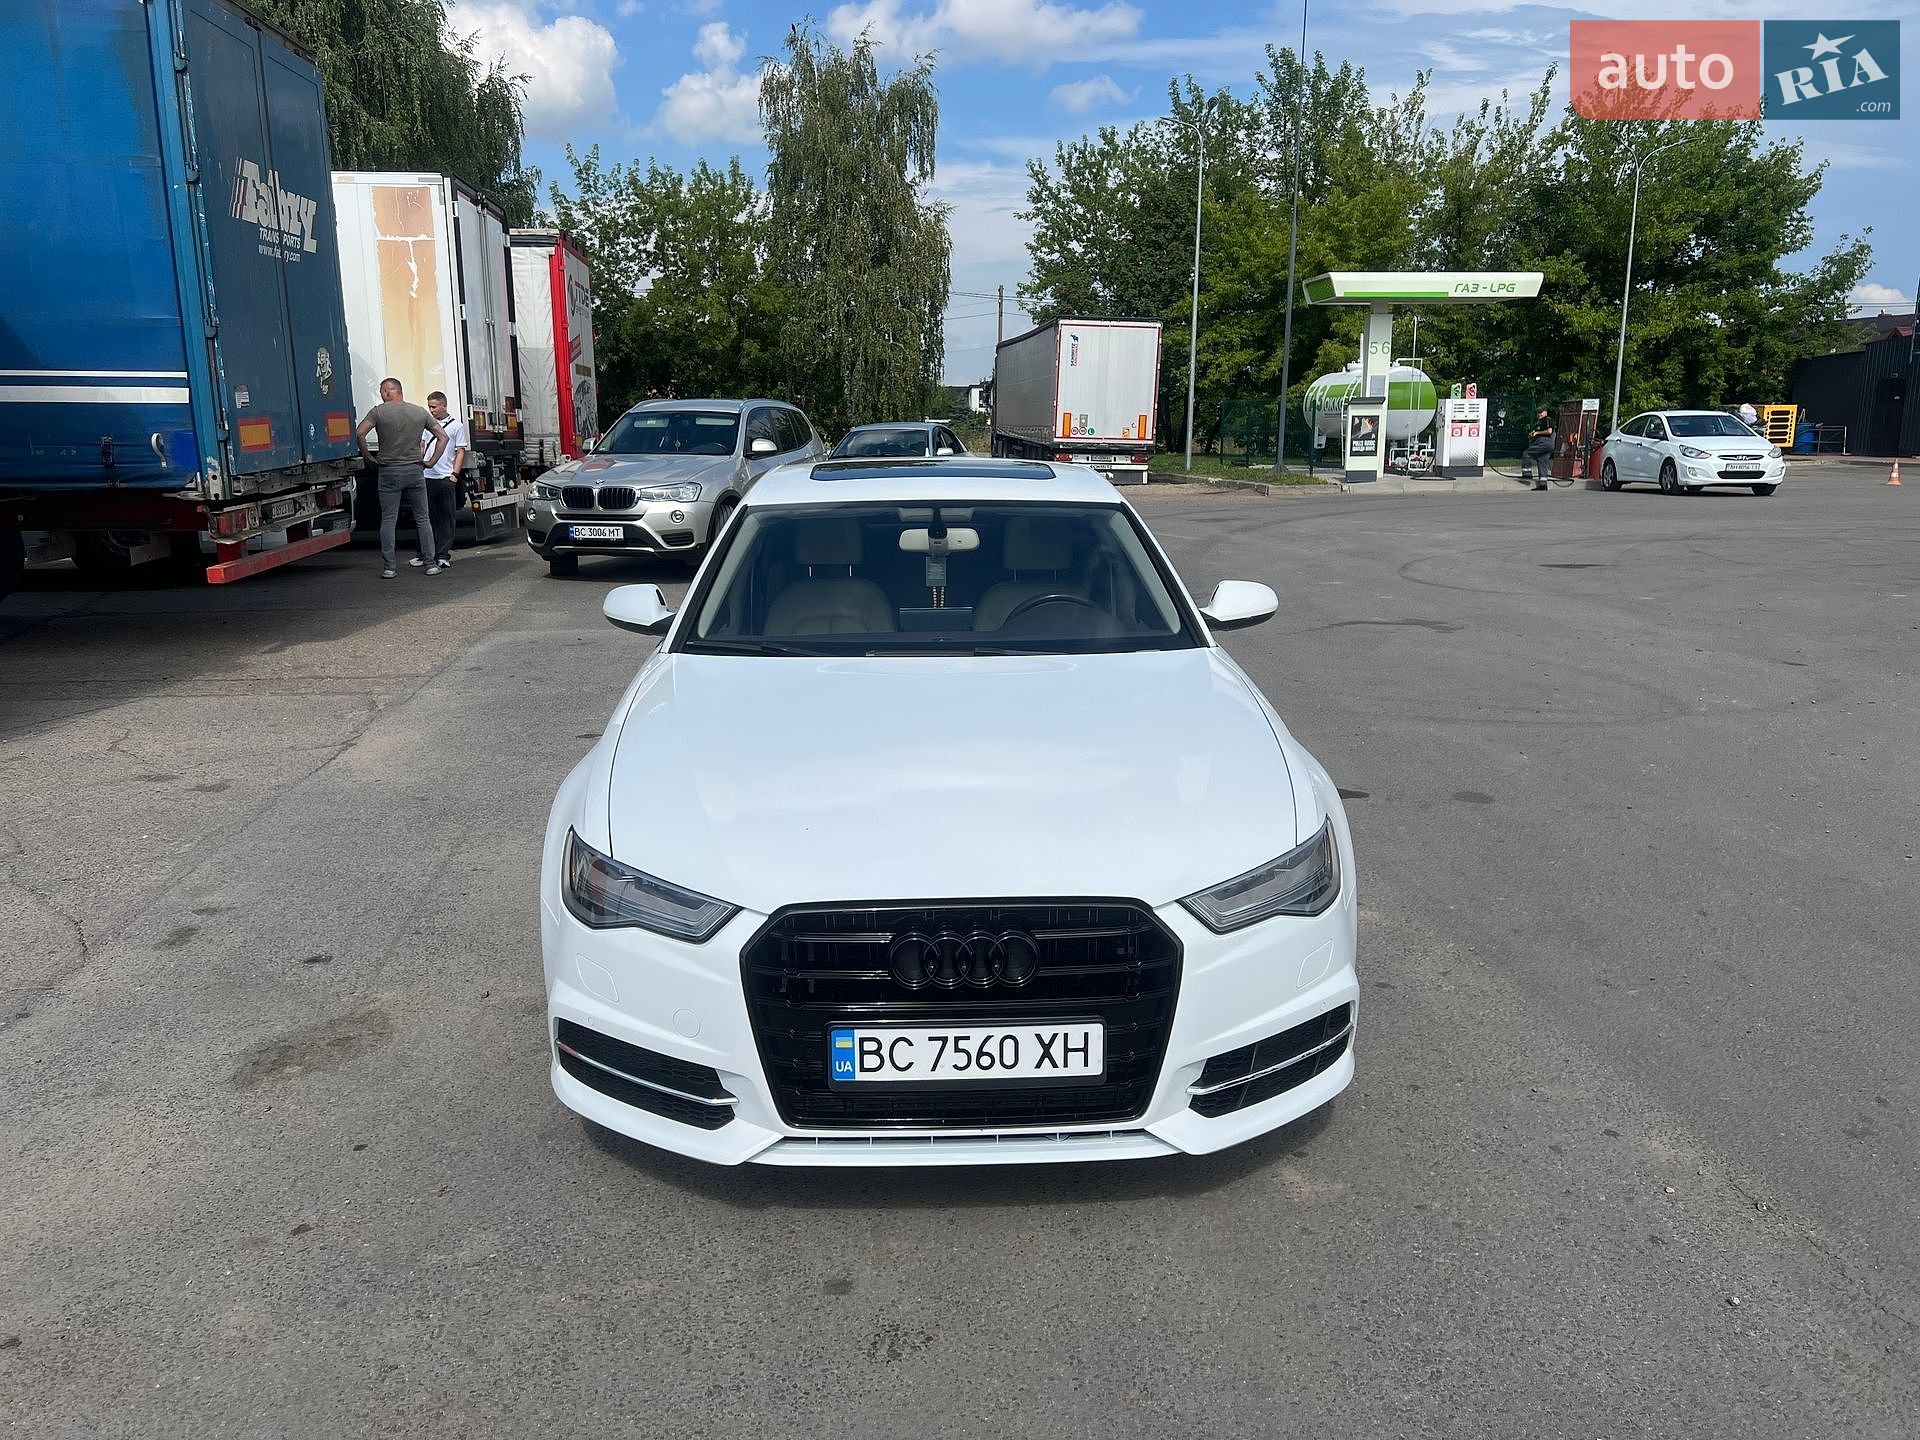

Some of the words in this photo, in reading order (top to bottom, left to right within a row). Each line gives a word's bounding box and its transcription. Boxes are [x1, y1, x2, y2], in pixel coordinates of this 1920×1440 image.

[1454, 283, 1479, 293] ГАЗ
[1489, 283, 1516, 293] LPG
[574, 528, 587, 537] BC
[588, 528, 606, 537] 3006
[608, 529, 621, 537] MT
[858, 1036, 915, 1073] BC
[927, 1034, 1020, 1072] 7560
[1034, 1031, 1089, 1069] XH
[835, 1060, 853, 1073] UA
